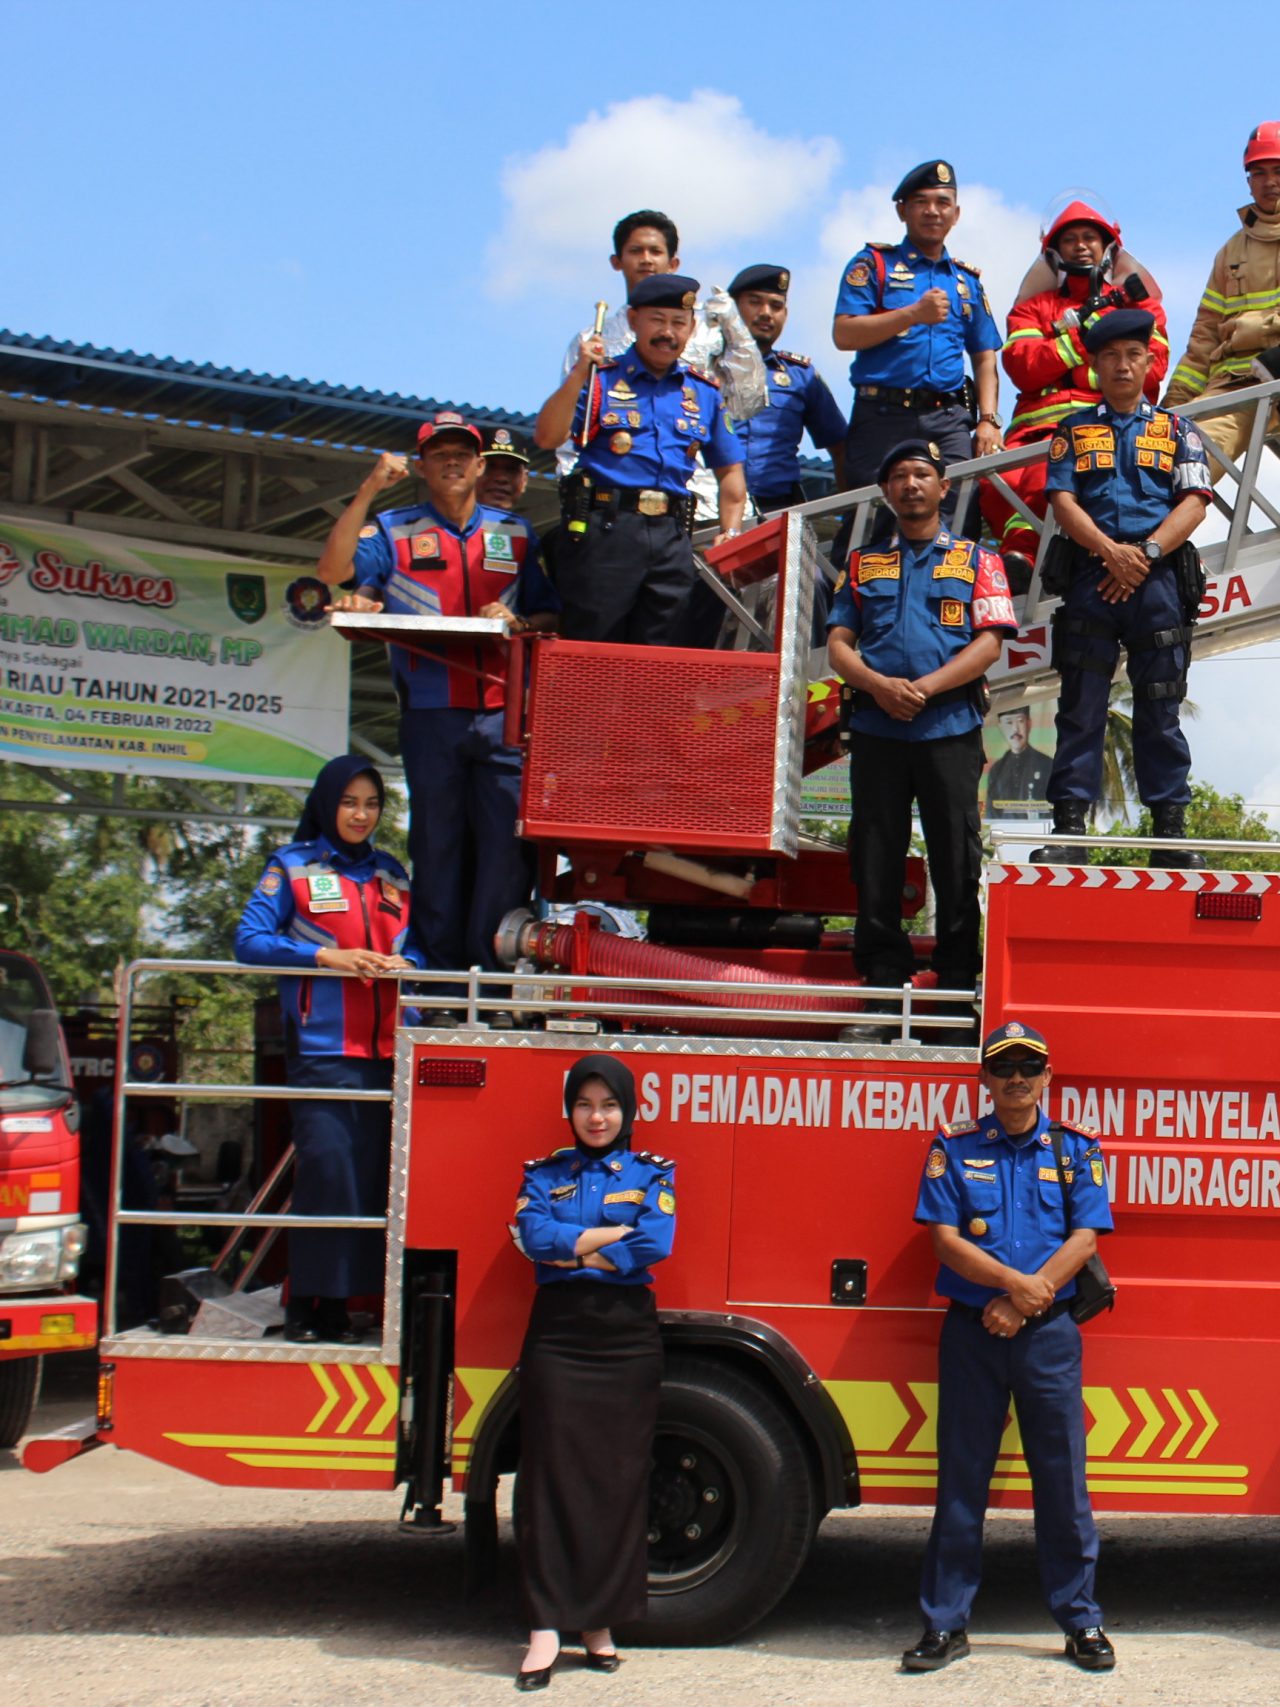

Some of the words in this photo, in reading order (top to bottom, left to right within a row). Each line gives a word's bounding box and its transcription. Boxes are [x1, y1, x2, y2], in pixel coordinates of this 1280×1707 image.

[31, 551, 176, 607] Sukses
[23, 651, 82, 671] Sebagai
[83, 621, 215, 667] WARDAN,
[219, 637, 263, 667] MP
[8, 670, 64, 695] RIAU
[72, 676, 157, 704] TAHUN
[164, 686, 283, 715] 2021-2025
[12, 727, 114, 750] PENYELAMATAN
[152, 743, 188, 756] INHIL
[65, 708, 86, 722] 04
[90, 710, 171, 729] FEBRUARI
[174, 717, 212, 733] 2022
[671, 1073, 830, 1127] PEMADAM
[1061, 1086, 1125, 1137] DAN
